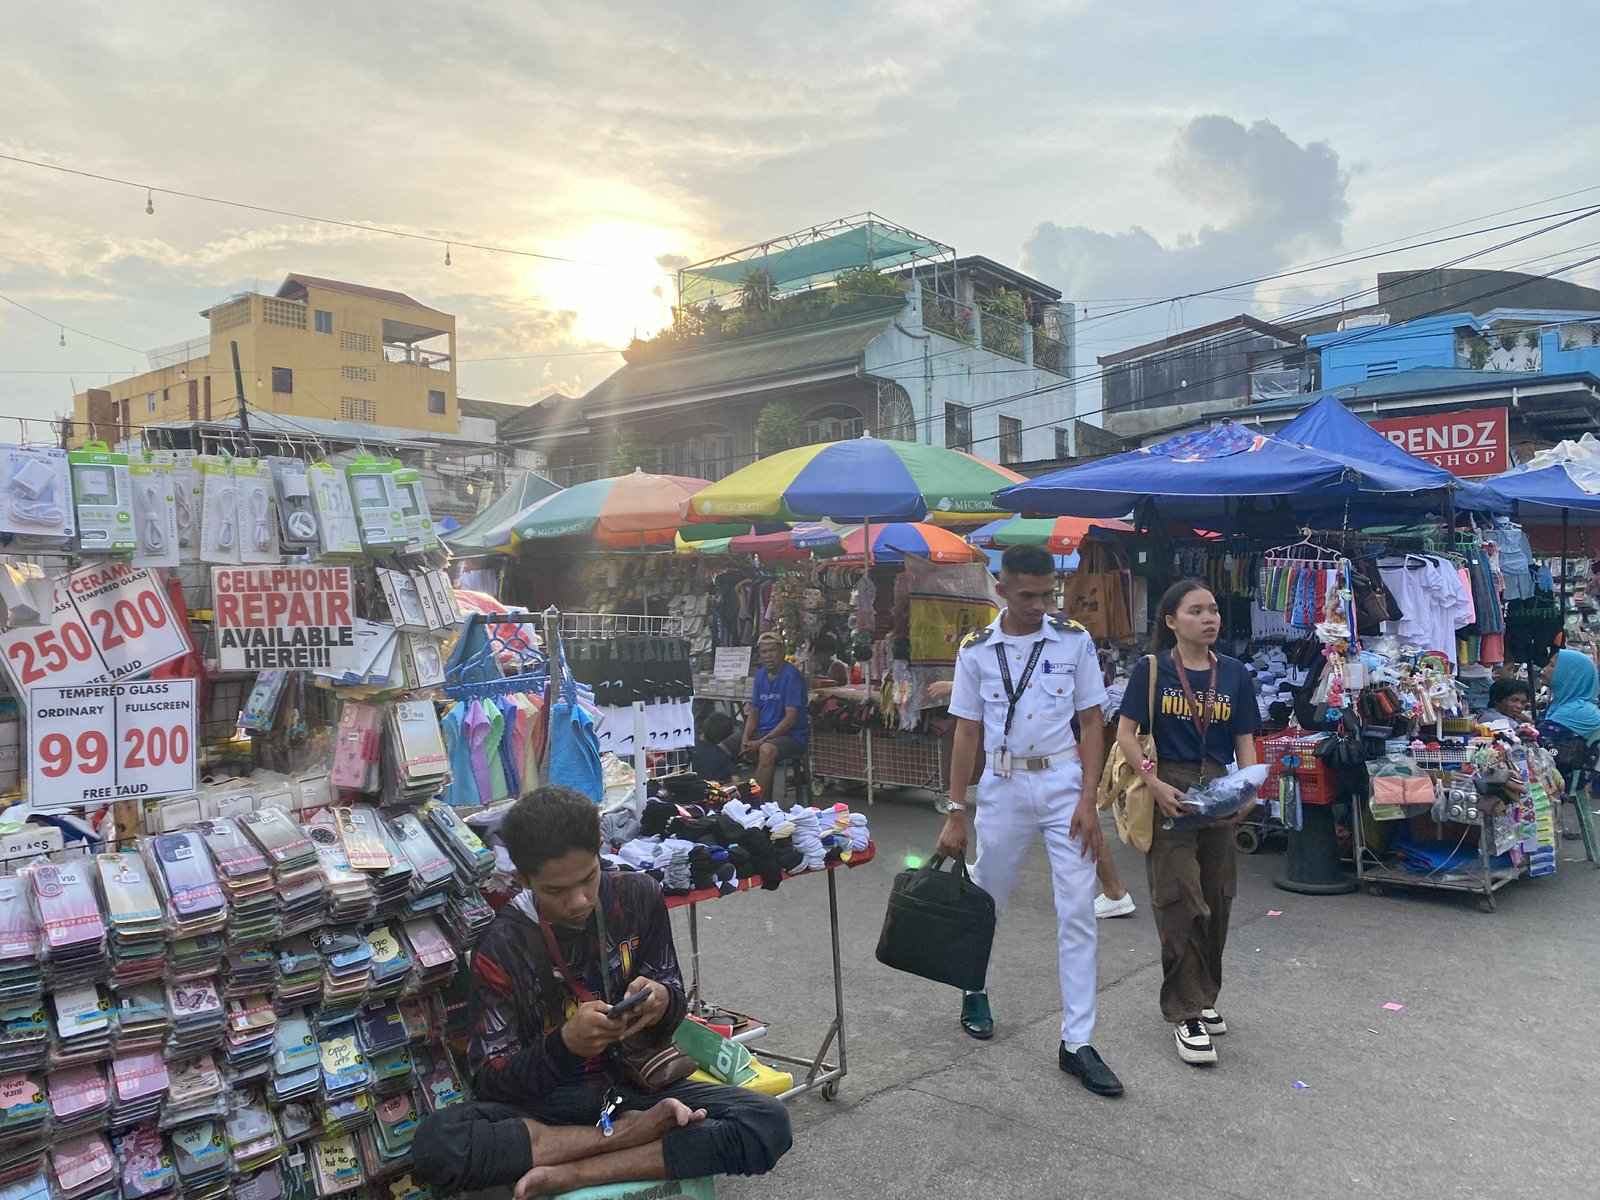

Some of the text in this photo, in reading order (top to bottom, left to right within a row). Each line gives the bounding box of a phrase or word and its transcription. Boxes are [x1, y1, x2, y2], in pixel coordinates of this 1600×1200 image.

[1379, 421, 1497, 452] RENDZ
[1421, 452, 1495, 467] SHOP
[955, 501, 999, 510] MICROM
[77, 582, 119, 603] TEMPERED
[121, 570, 148, 587] GLASS
[217, 568, 349, 593] CELLPHONE
[90, 590, 167, 652] 200
[217, 591, 353, 628] REPAIR
[221, 626, 354, 649] AVAILABLE
[8, 621, 92, 685] 250
[244, 647, 331, 669] HERE!!!
[109, 659, 142, 679] TAUD
[59, 683, 169, 699] TEMPERED GLASS
[37, 705, 105, 718] ORDINARY
[125, 700, 190, 713] FULLSCREEN
[1161, 696, 1231, 721] NURSNG
[38, 730, 109, 778] 99
[123, 724, 189, 769] 200
[83, 783, 148, 799] FREE TAUD
